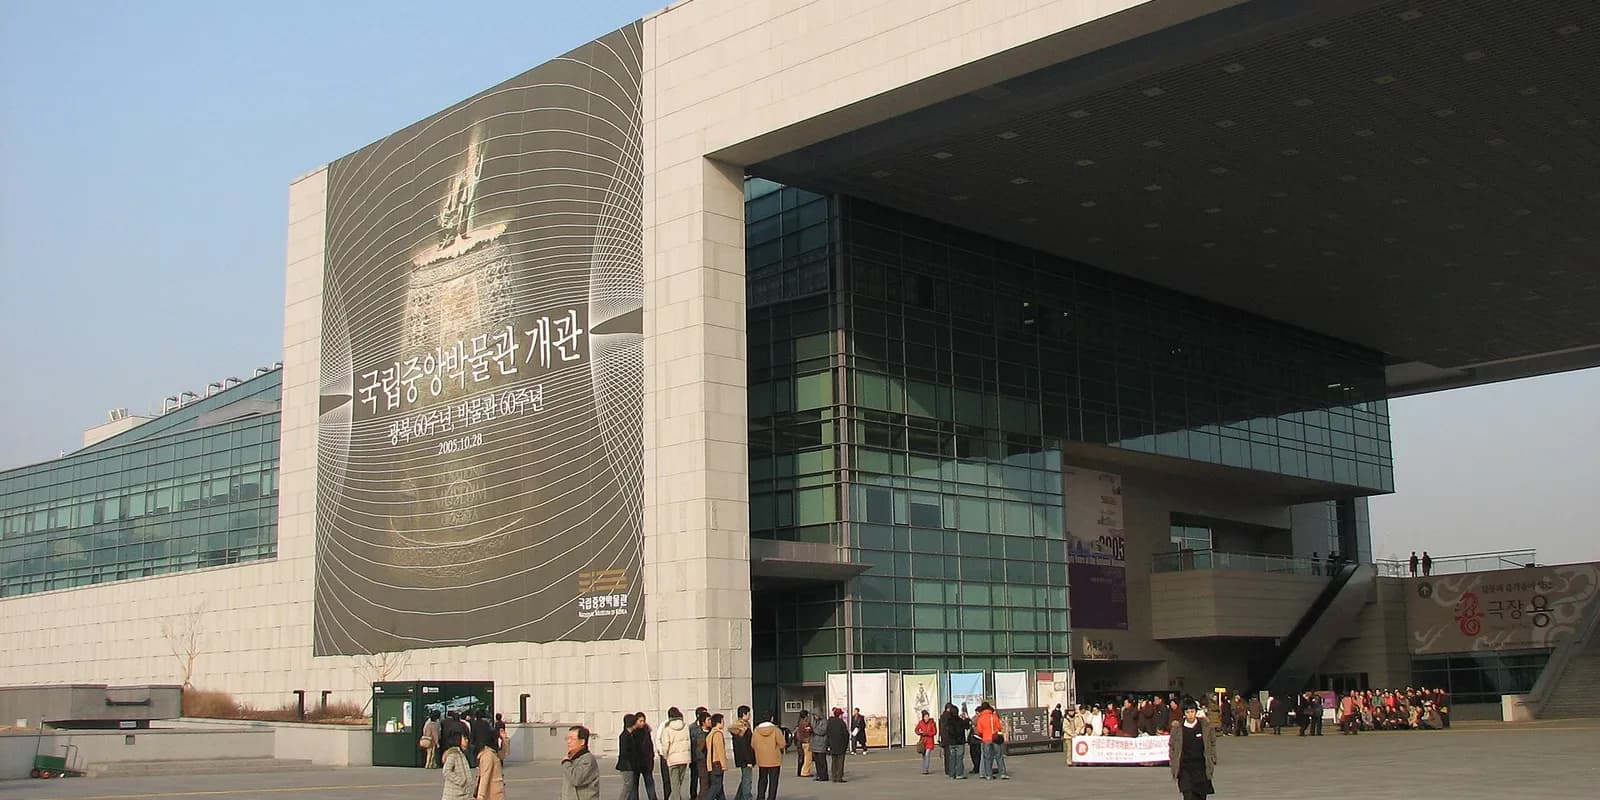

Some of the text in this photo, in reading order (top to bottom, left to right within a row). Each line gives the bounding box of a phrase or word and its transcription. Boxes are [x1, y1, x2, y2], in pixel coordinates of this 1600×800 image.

[358, 309, 583, 415] 국립중앙박물관 개관
[388, 383, 545, 446] 광복 60주년, 박물관 60주년
[438, 432, 483, 456] 2005.10.28
[578, 594, 627, 610] 국립중앙박물관
[1488, 594, 1555, 628] 극장 용
